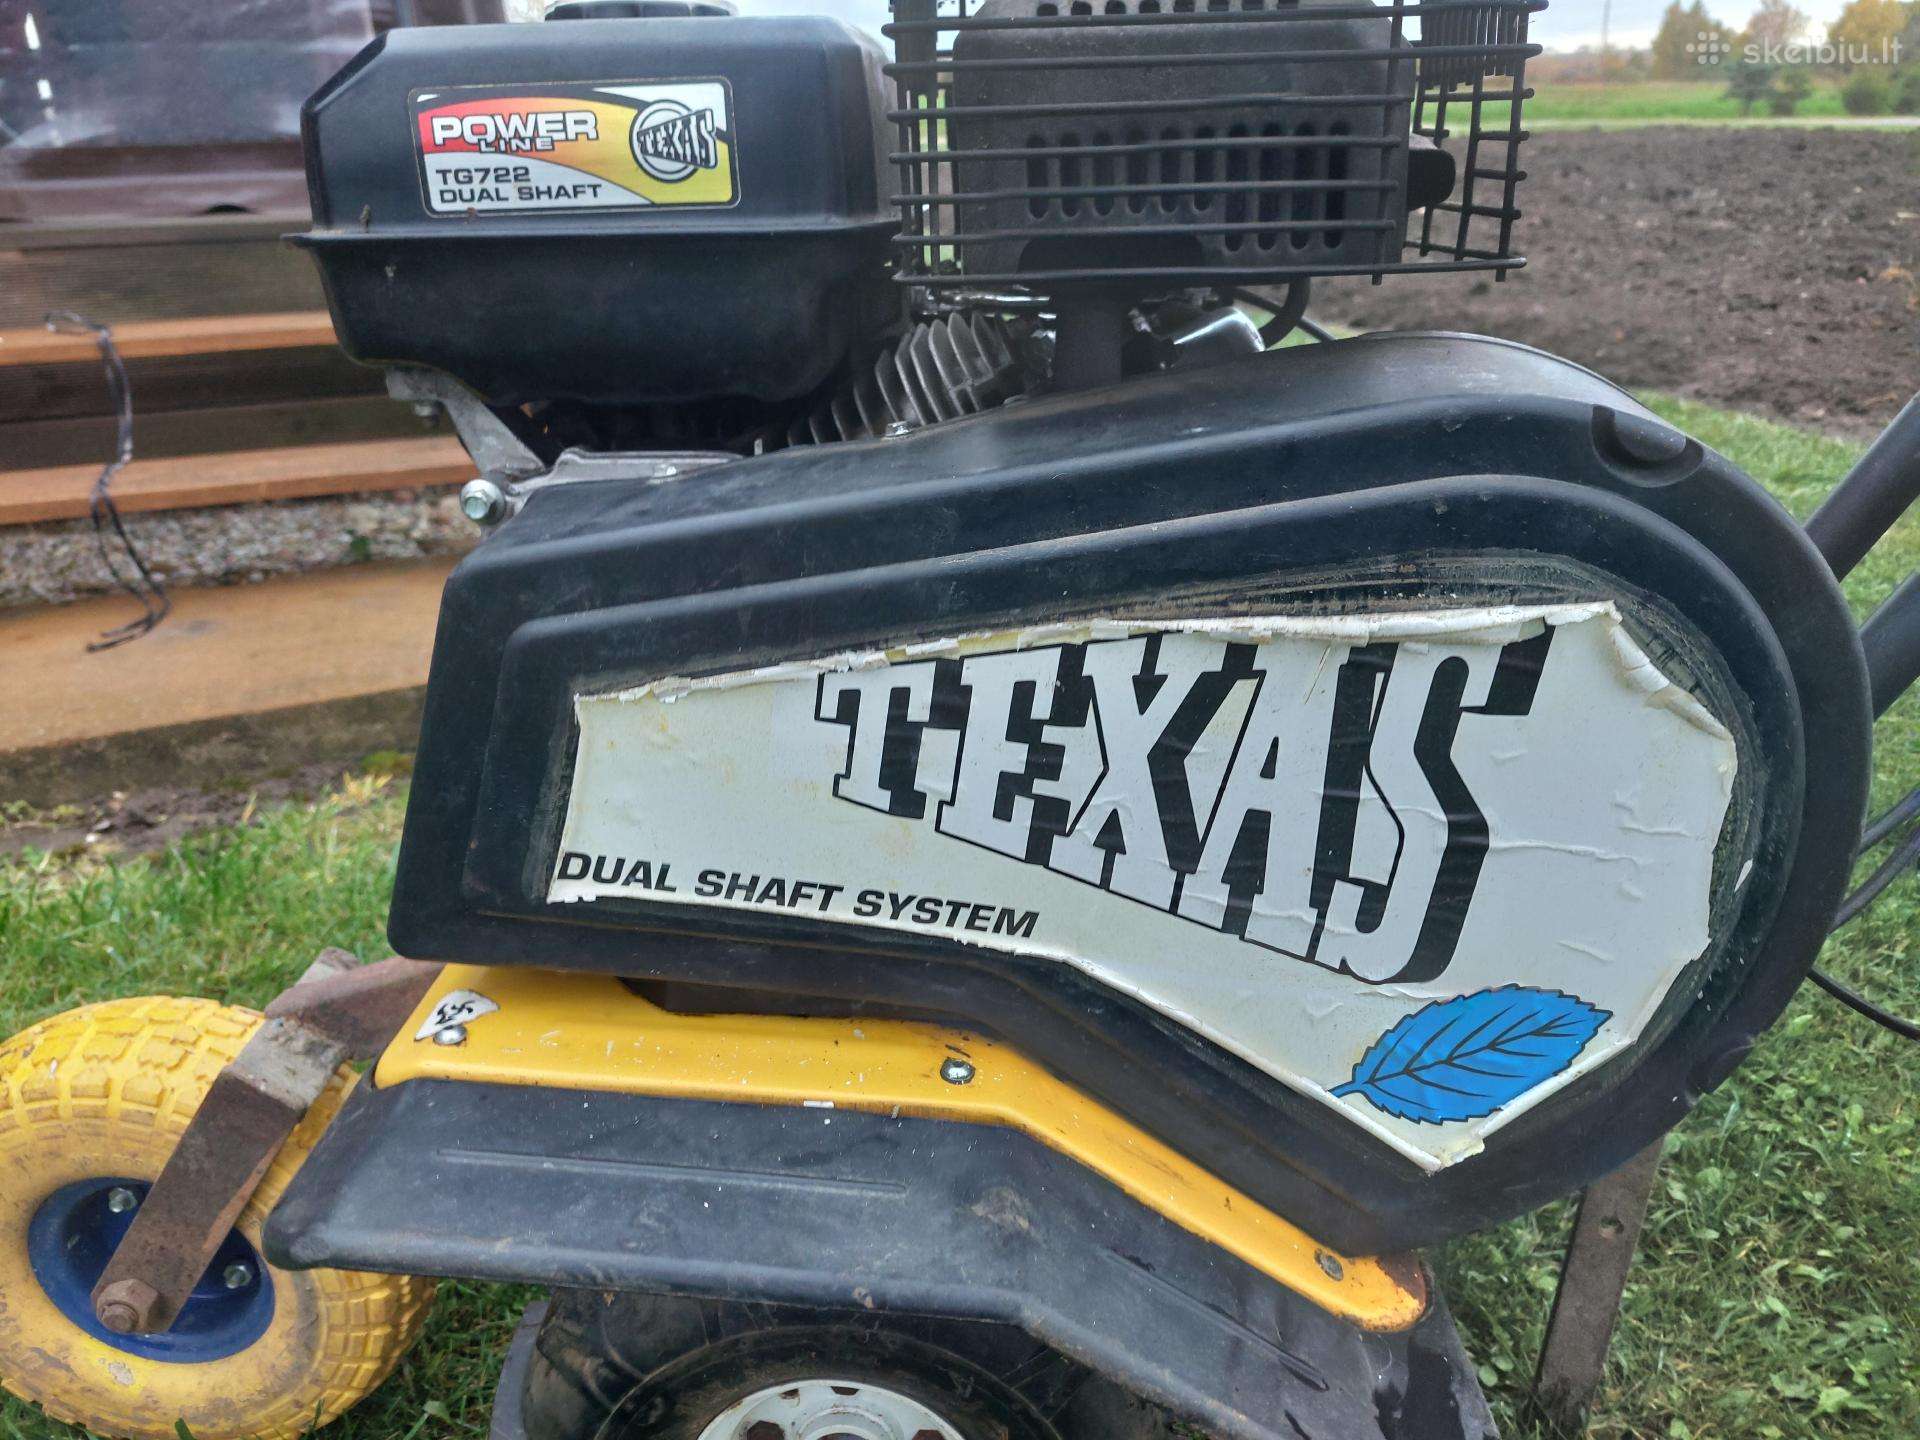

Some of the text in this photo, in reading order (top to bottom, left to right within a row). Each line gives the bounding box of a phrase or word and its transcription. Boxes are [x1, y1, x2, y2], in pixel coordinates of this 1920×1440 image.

[432, 111, 598, 145] POWER
[479, 137, 556, 153] LINE
[638, 108, 718, 169] TEXAS
[436, 166, 531, 184] TG722
[440, 184, 602, 204] DUAL SHAFT
[814, 625, 1556, 985] TEXAS
[557, 851, 1040, 939] DUAL SHAFT SYSTEM
